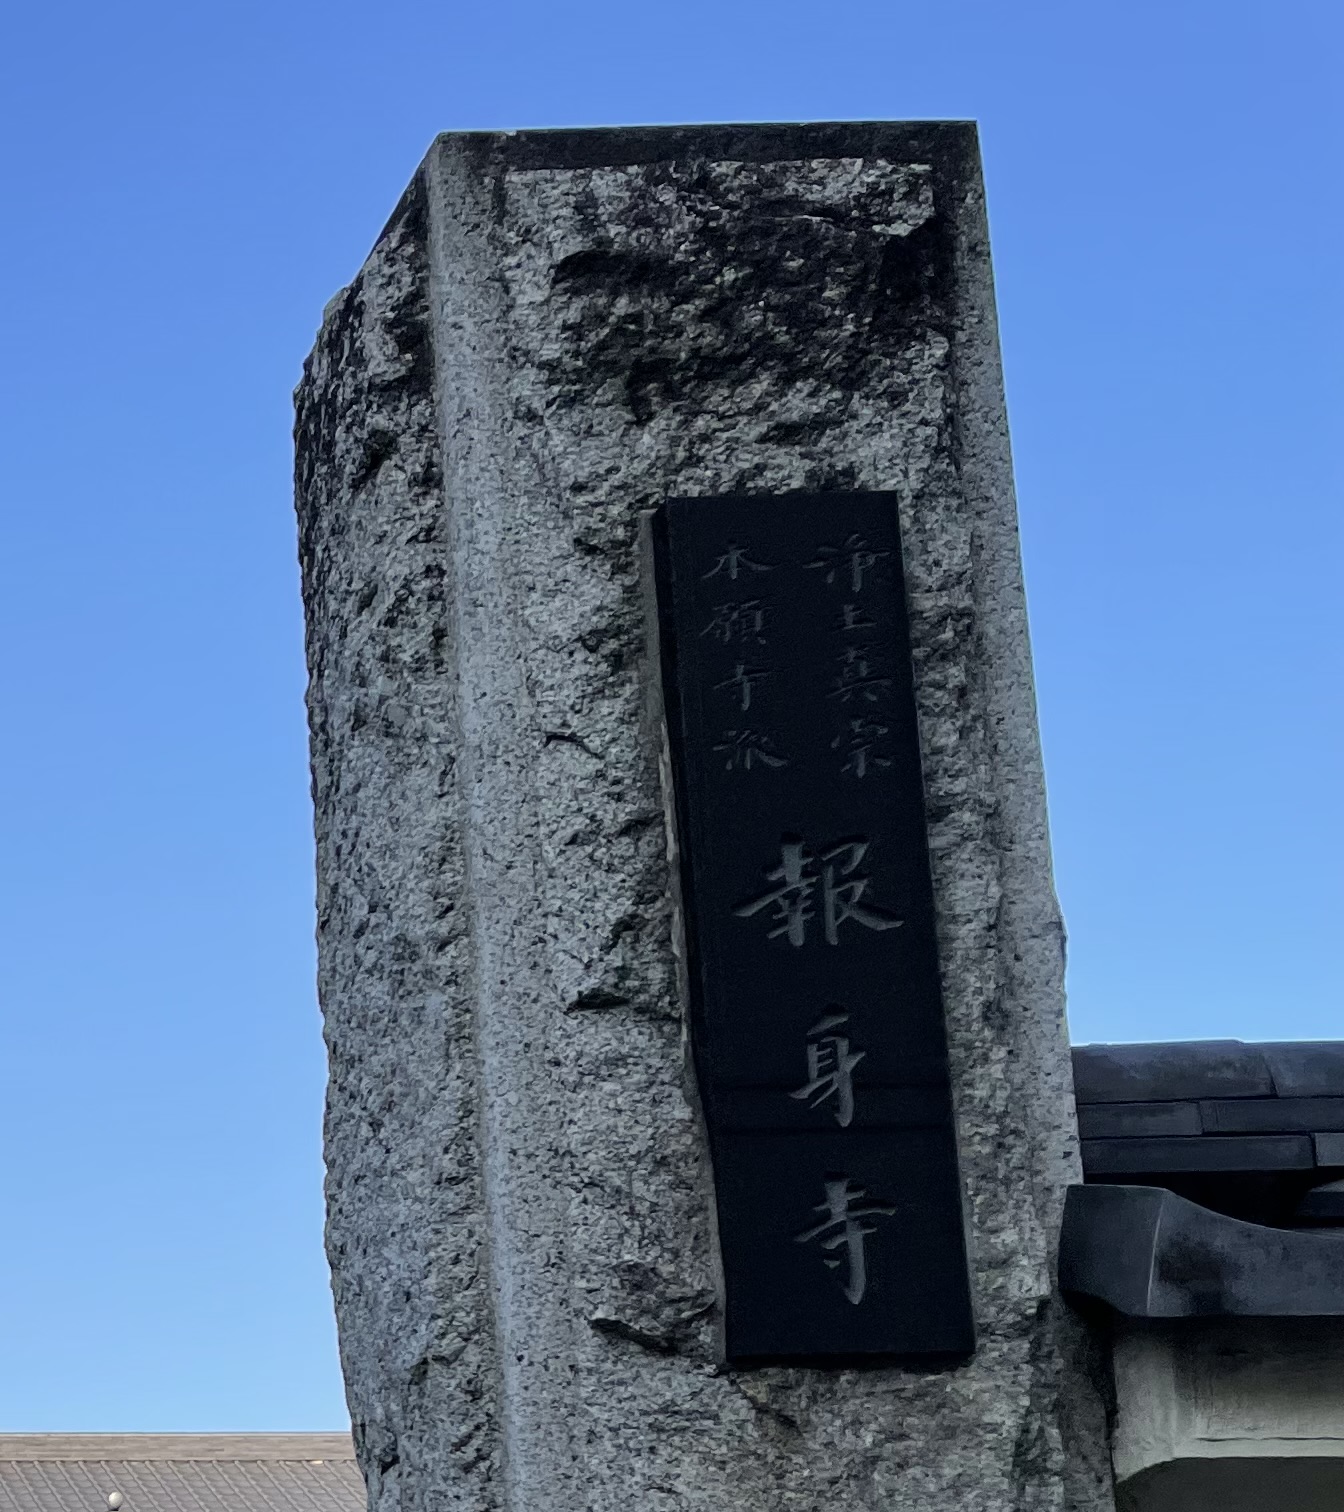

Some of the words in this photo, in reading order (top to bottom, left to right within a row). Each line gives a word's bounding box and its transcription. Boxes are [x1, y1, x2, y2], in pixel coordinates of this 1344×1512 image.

[699, 541, 791, 771] 本願寺派
[732, 835, 905, 1306] 報身寺
